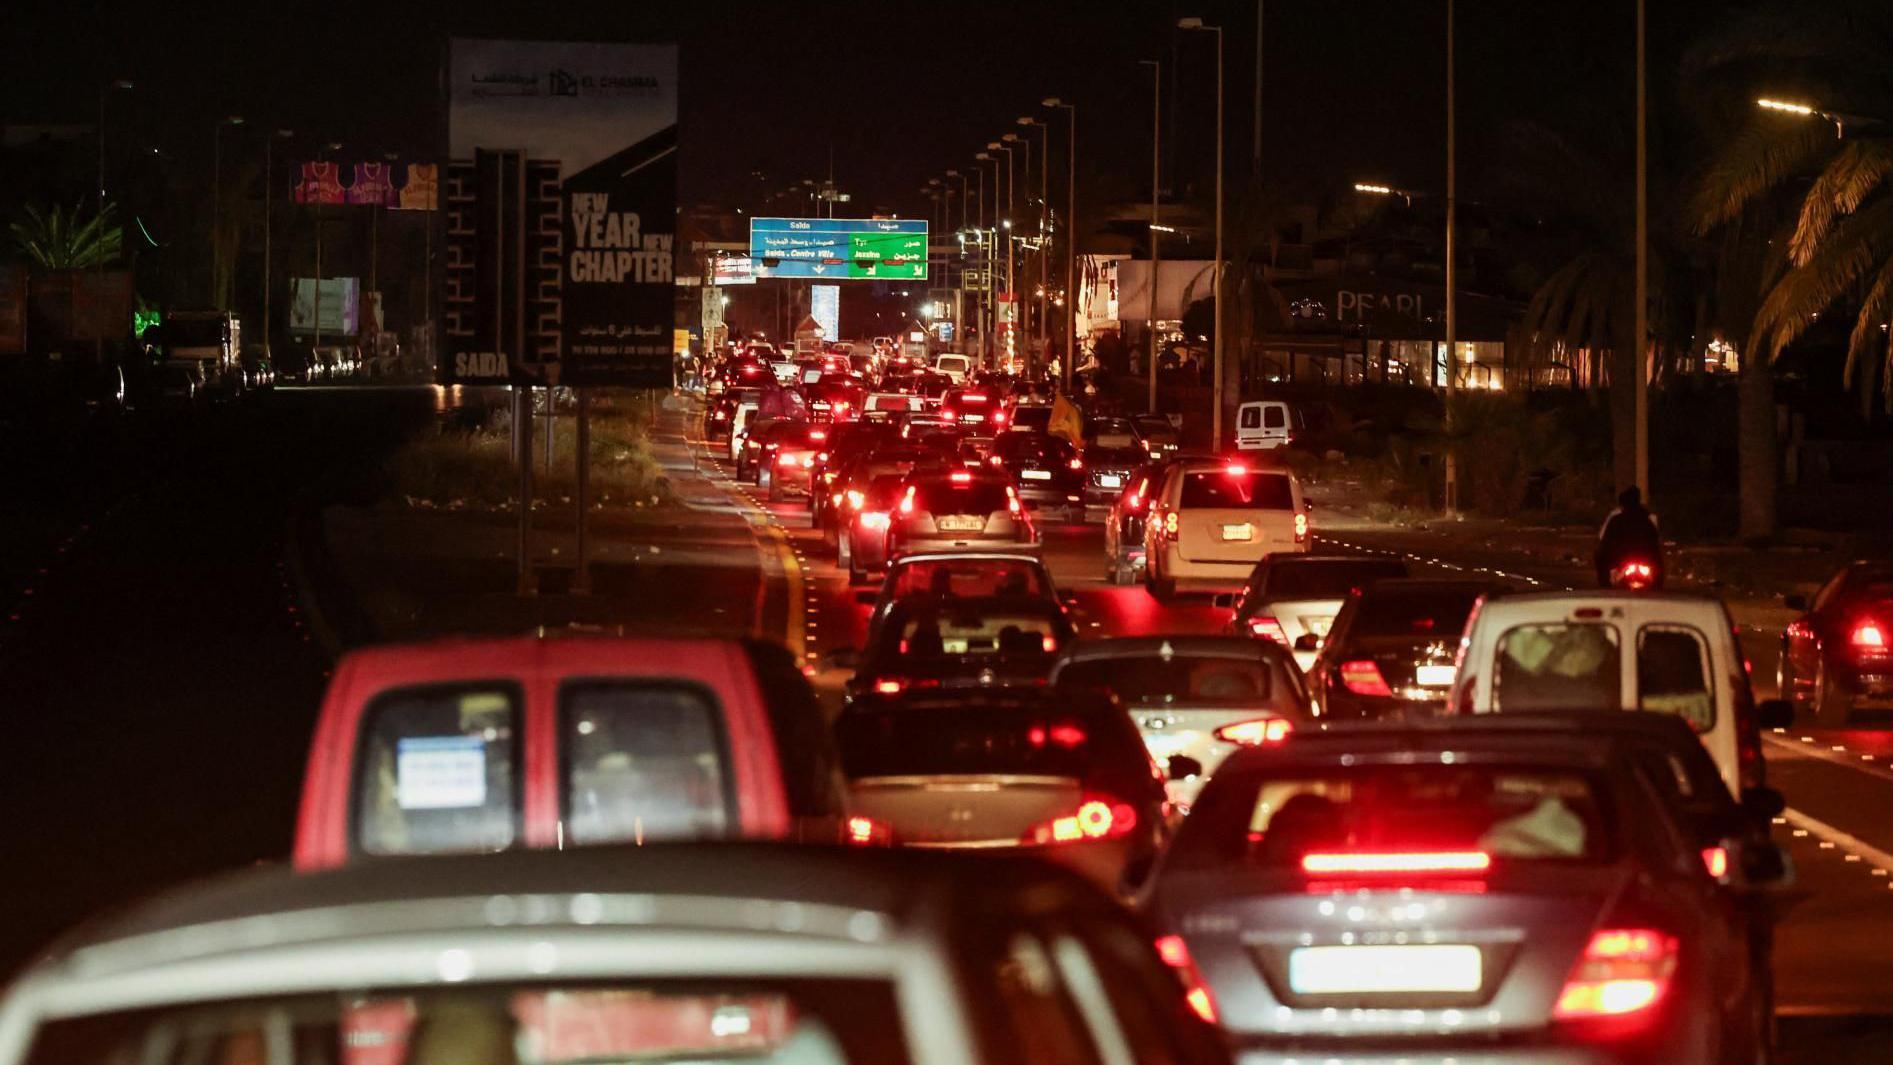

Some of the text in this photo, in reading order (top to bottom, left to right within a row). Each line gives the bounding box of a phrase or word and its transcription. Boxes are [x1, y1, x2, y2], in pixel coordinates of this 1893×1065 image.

[572, 193, 608, 213] NEW
[572, 212, 674, 251] YEAR NEW
[570, 250, 673, 283] CHAPTER
[455, 352, 510, 378] SAIDA
